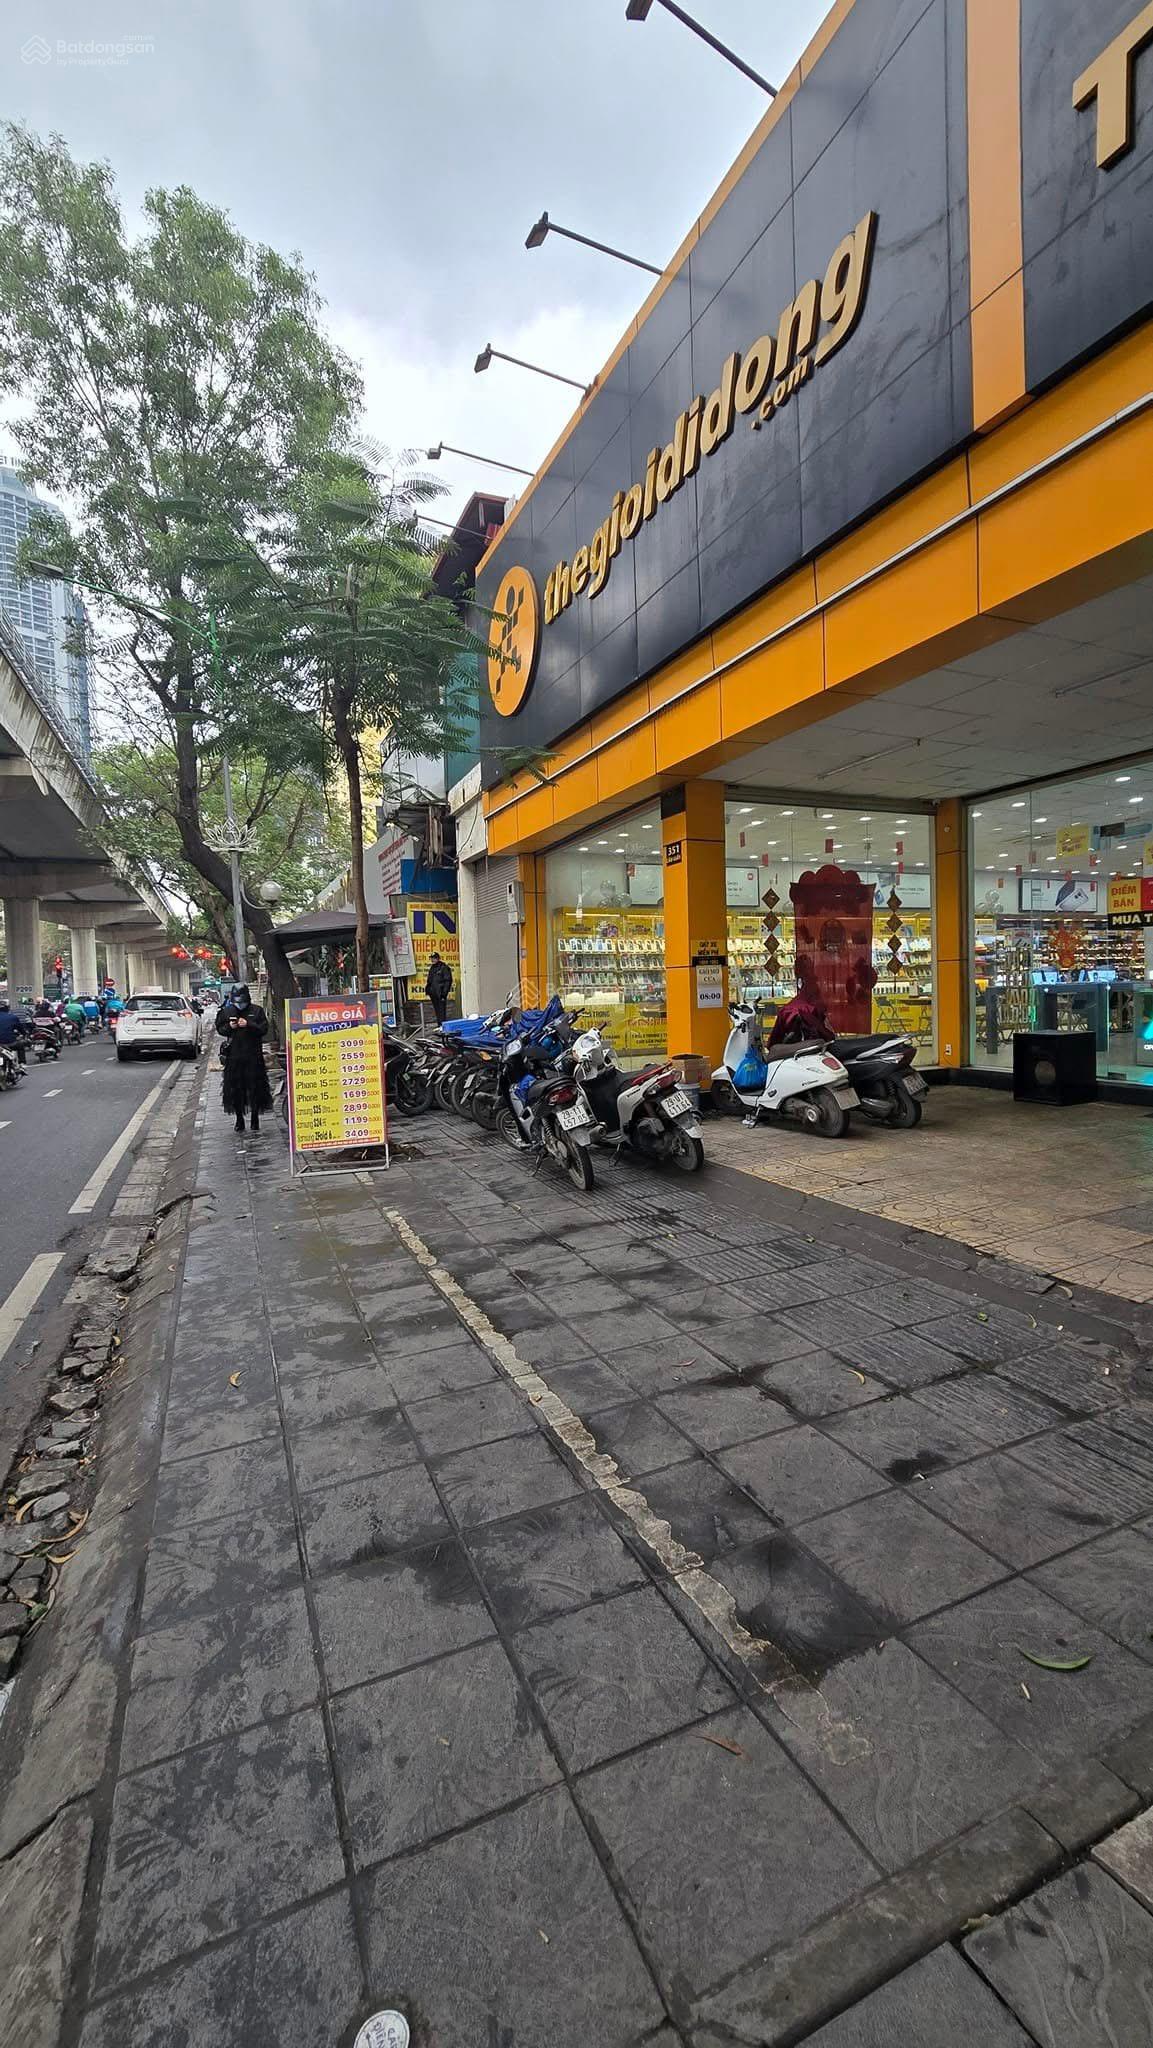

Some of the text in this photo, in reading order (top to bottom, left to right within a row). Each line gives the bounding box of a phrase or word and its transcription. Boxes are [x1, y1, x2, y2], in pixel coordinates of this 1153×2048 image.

[543, 210, 877, 625] thegioididong
[667, 843, 681, 857] 351
[411, 911, 456, 934] IN
[1112, 914, 1142, 925] MUA
[342, 1006, 364, 1020] GIÁ
[295, 1042, 316, 1051] iPhone
[318, 1041, 327, 1049] 16
[295, 1055, 316, 1063] iPhone
[319, 1053, 328, 1061] 16
[296, 1067, 317, 1076] iPhone
[319, 1066, 328, 1075] 16
[296, 1080, 317, 1089] iPhone
[320, 1079, 328, 1087] 15
[297, 1093, 318, 1102] iPhone
[320, 1092, 329, 1100] 15
